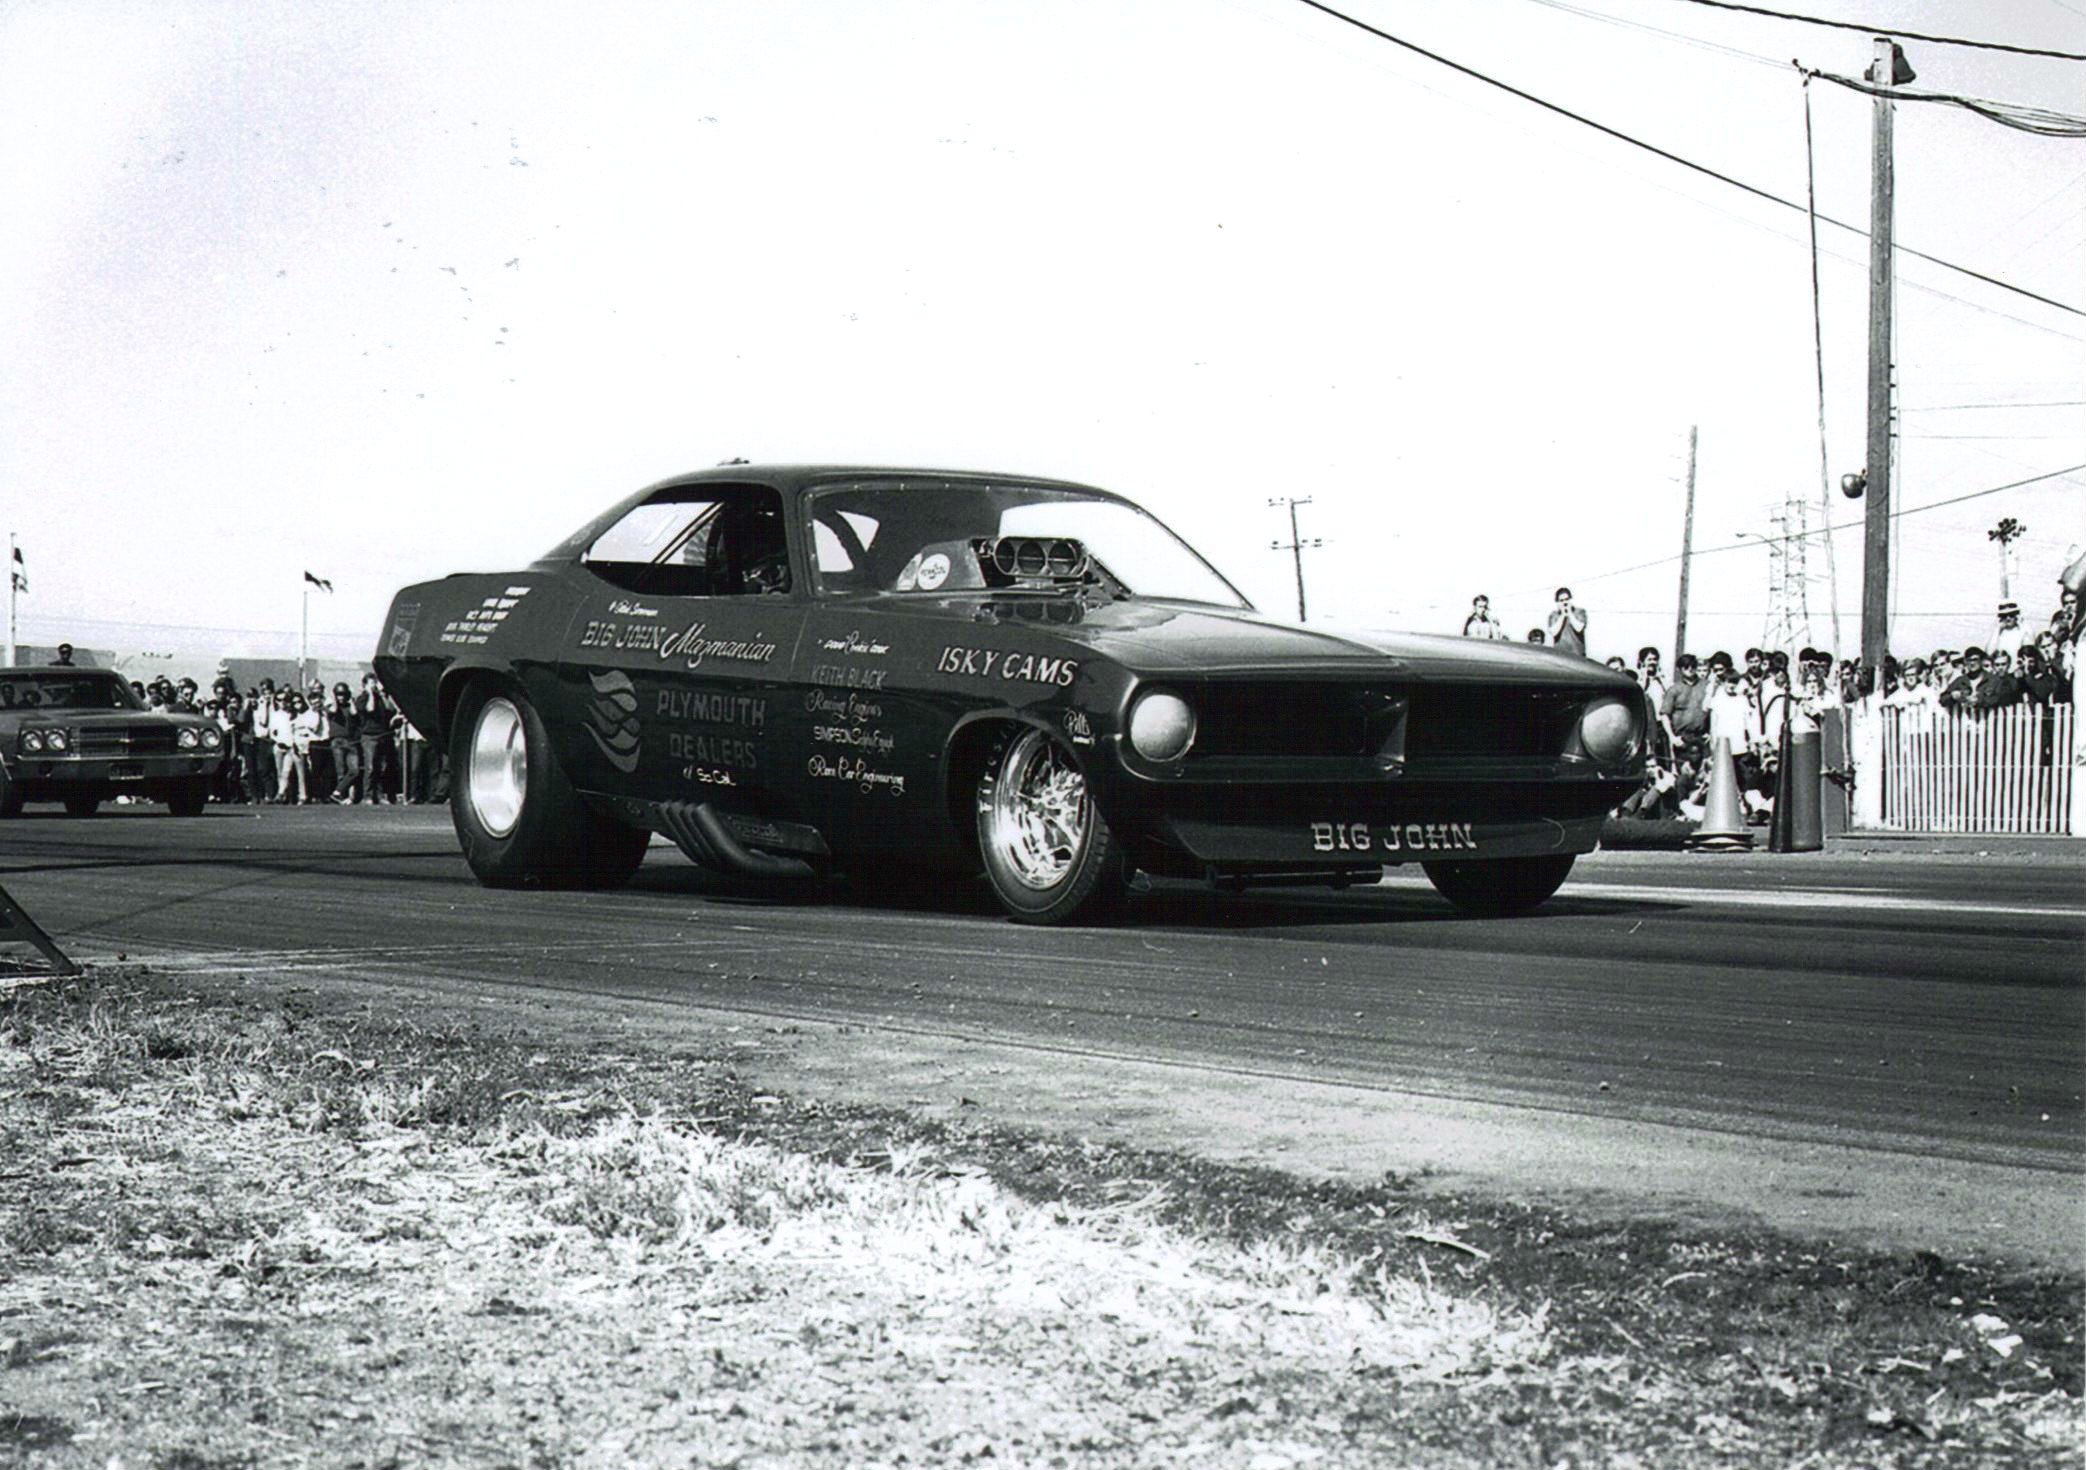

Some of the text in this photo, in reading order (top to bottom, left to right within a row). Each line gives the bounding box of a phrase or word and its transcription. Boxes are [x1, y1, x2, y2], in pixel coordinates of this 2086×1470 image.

[581, 621, 776, 668] BIG JOHN Mazmanian
[847, 667, 888, 691] BLACK
[938, 646, 1078, 687] ISKY CAMS
[656, 689, 767, 726] PLYMOUTH
[669, 733, 758, 769] DEALERS
[1311, 822, 1478, 851] BIG JOHN
